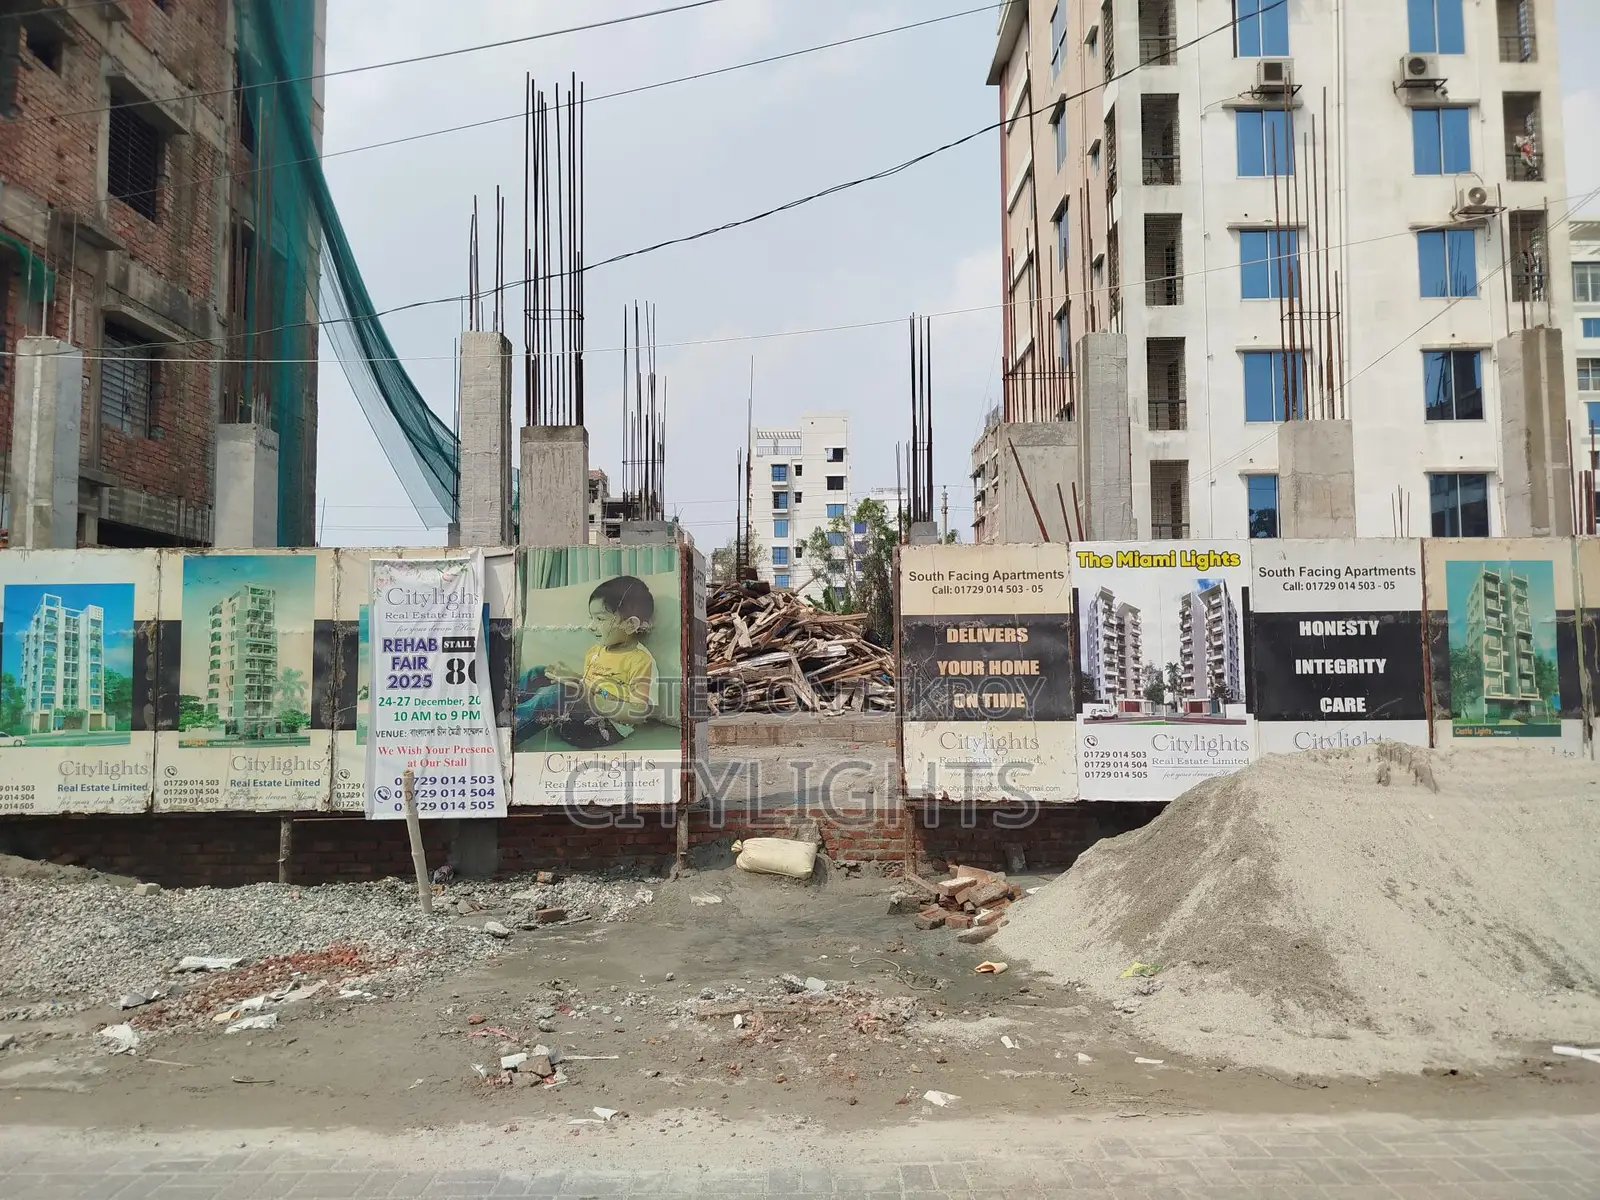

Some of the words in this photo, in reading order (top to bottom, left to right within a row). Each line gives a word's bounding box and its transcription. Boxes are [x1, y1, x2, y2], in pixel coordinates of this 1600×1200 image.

[1077, 551, 1113, 568] The
[1116, 550, 1176, 568] Miami
[1180, 550, 1241, 572] Lights
[909, 571, 944, 582] South
[949, 570, 989, 583] Facing
[993, 569, 1065, 581] Apartments
[1259, 567, 1295, 578] South
[1299, 566, 1341, 579] Facing
[1344, 565, 1416, 578] Apartments
[932, 586, 953, 595] Call:
[954, 585, 984, 594] 01729
[986, 585, 1004, 593] 014
[1006, 584, 1024, 593] 503
[1031, 584, 1043, 593] 05
[1282, 582, 1304, 591] Call:
[1306, 582, 1336, 590] 01729
[1338, 582, 1356, 590] 014
[1359, 581, 1376, 590] 503
[1383, 581, 1396, 590] 05
[413, 611, 447, 619] Estate
[1299, 620, 1379, 636] HONESTY
[946, 627, 1029, 643] DELIVERS
[382, 637, 438, 653] REHAB
[443, 640, 472, 649] STALL
[391, 656, 428, 671] FAIR
[937, 660, 985, 676] YOUR
[988, 660, 1040, 675] HOME
[1295, 658, 1386, 674] INTEGRITY
[386, 674, 433, 690] 2025
[378, 697, 410, 707] 24-27
[414, 698, 465, 707] December,
[953, 693, 979, 709] ON
[981, 693, 1026, 709] TIME
[1319, 697, 1367, 713] CARE
[394, 712, 408, 721] 10
[411, 711, 431, 721] AM
[435, 712, 447, 721] to
[451, 711, 458, 720] 9
[462, 710, 481, 720] PM
[376, 730, 407, 738] VENUE:
[939, 731, 1040, 755] Citylights
[1152, 733, 1250, 757] Citylights
[378, 746, 394, 756] We
[397, 746, 422, 755] Wish
[425, 745, 450, 754] Your
[231, 755, 321, 775] Citylights
[407, 760, 416, 768] at
[420, 759, 441, 767] Our
[444, 758, 467, 767] Stall
[939, 756, 959, 764] Real
[965, 756, 998, 764] Estate
[1001, 755, 1040, 764] Limited
[1212, 757, 1250, 765] Limited
[58, 760, 148, 780] Citylights
[546, 752, 656, 779] Citylights
[394, 776, 437, 786] 0729
[440, 776, 466, 785] 014
[470, 775, 495, 784] 503
[1085, 771, 1112, 779] 01729
[21, 784, 35, 792] 503
[58, 784, 78, 792] Real
[80, 784, 110, 792] Estate
[112, 783, 148, 792] Limited
[230, 779, 250, 787] Real
[253, 779, 282, 787] Estate
[284, 778, 320, 787] Limited
[545, 781, 569, 789] Real
[574, 780, 609, 788] Estate
[613, 779, 656, 787] Limited
[20, 793, 35, 801] 504
[394, 789, 437, 799] 0729
[440, 788, 466, 798] 014
[470, 788, 496, 797] 504
[20, 802, 34, 810] 505
[440, 801, 466, 810] 014
[470, 801, 495, 810] 505
